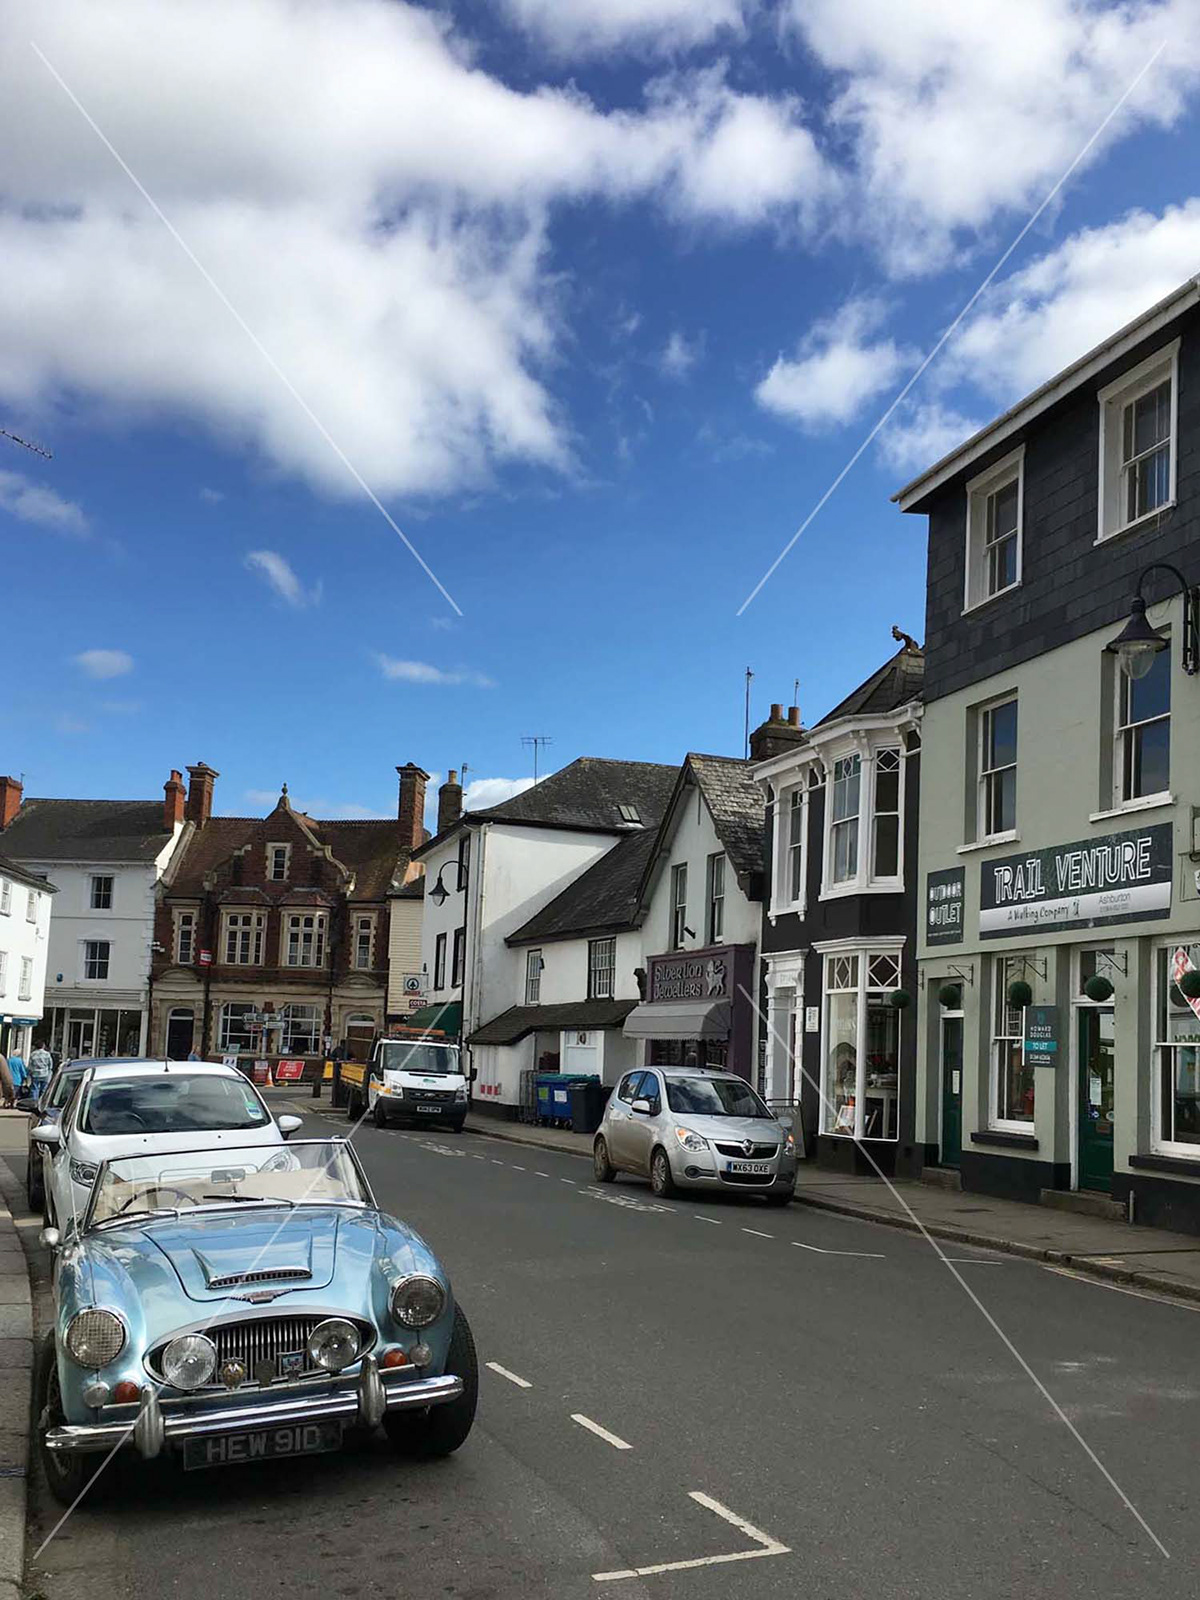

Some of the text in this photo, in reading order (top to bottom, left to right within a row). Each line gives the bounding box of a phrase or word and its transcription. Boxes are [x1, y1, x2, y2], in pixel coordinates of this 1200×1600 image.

[994, 837, 1152, 905] TRAIL VENTURE
[929, 881, 962, 902] OUTDOOR
[1098, 893, 1131, 905] Ashburton
[929, 902, 962, 926] OUTLET
[1013, 905, 1040, 924] Walking
[1040, 905, 1070, 920] Company
[1032, 1042, 1048, 1050] TO LET
[206, 1425, 321, 1462] HEW 91D
